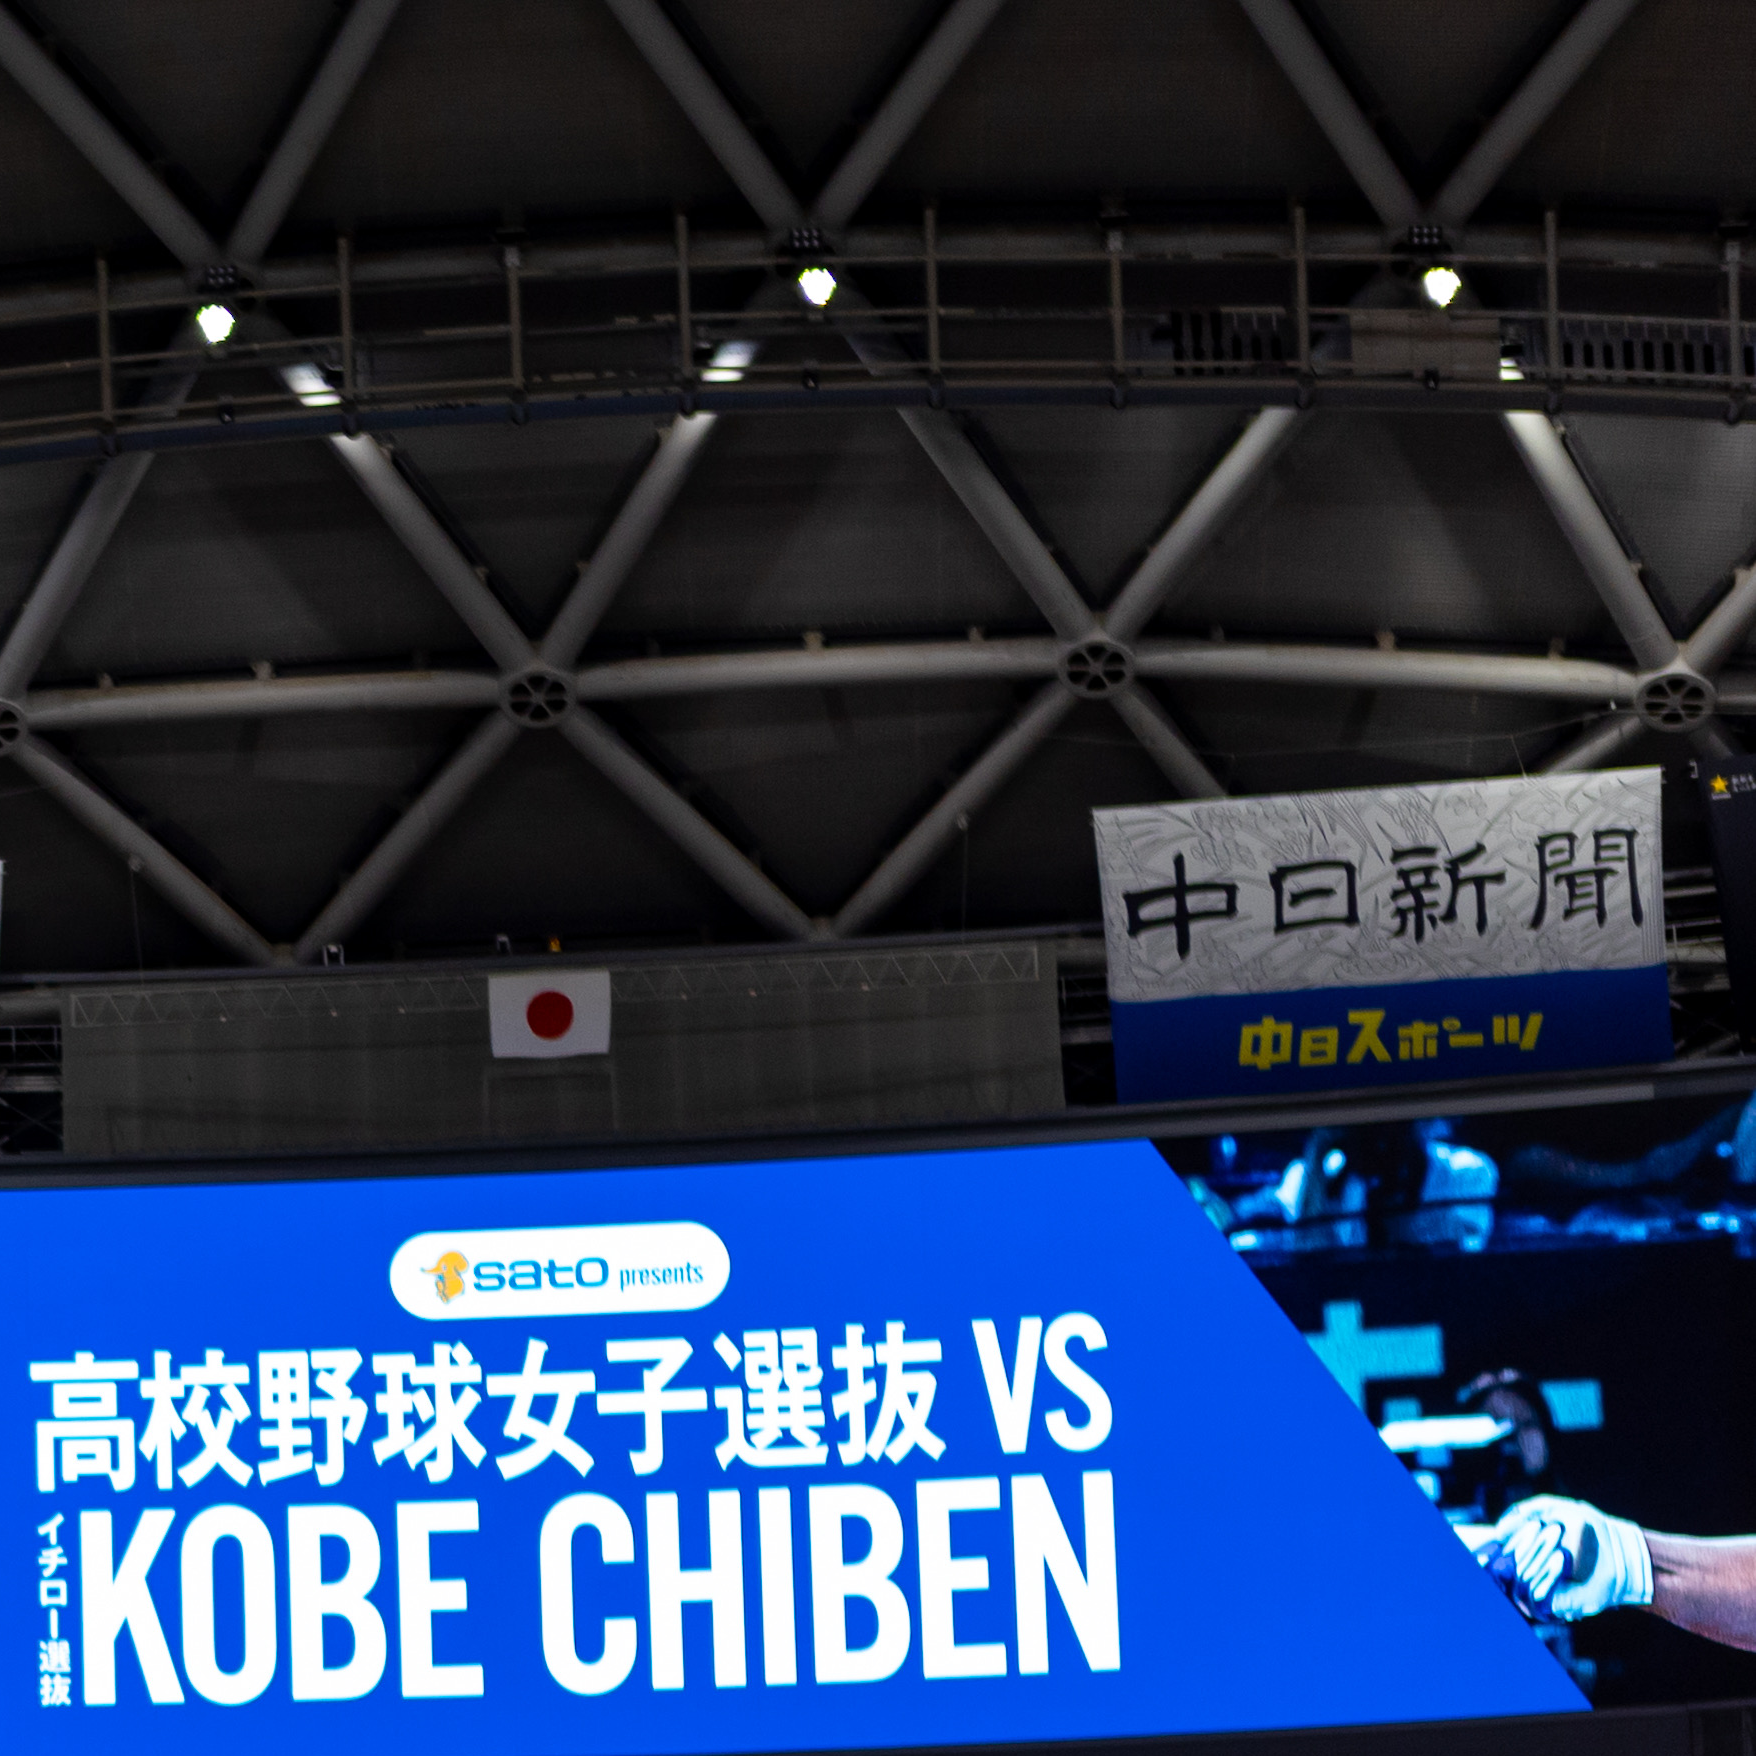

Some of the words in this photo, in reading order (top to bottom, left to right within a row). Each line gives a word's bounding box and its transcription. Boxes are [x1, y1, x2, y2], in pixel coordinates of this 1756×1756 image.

[1123, 828, 1645, 961] 中日新聞
[1238, 1009, 1544, 1071] 中日スポーツ
[472, 1256, 610, 1293] sato
[619, 1258, 704, 1293] presents
[30, 1327, 945, 1494] 高校野球女子選抜
[971, 1312, 1114, 1456] VS
[36, 1512, 72, 1708] イチロー選抜
[80, 1499, 484, 1708] KOBE
[537, 1471, 1121, 1698] CHIBEN
